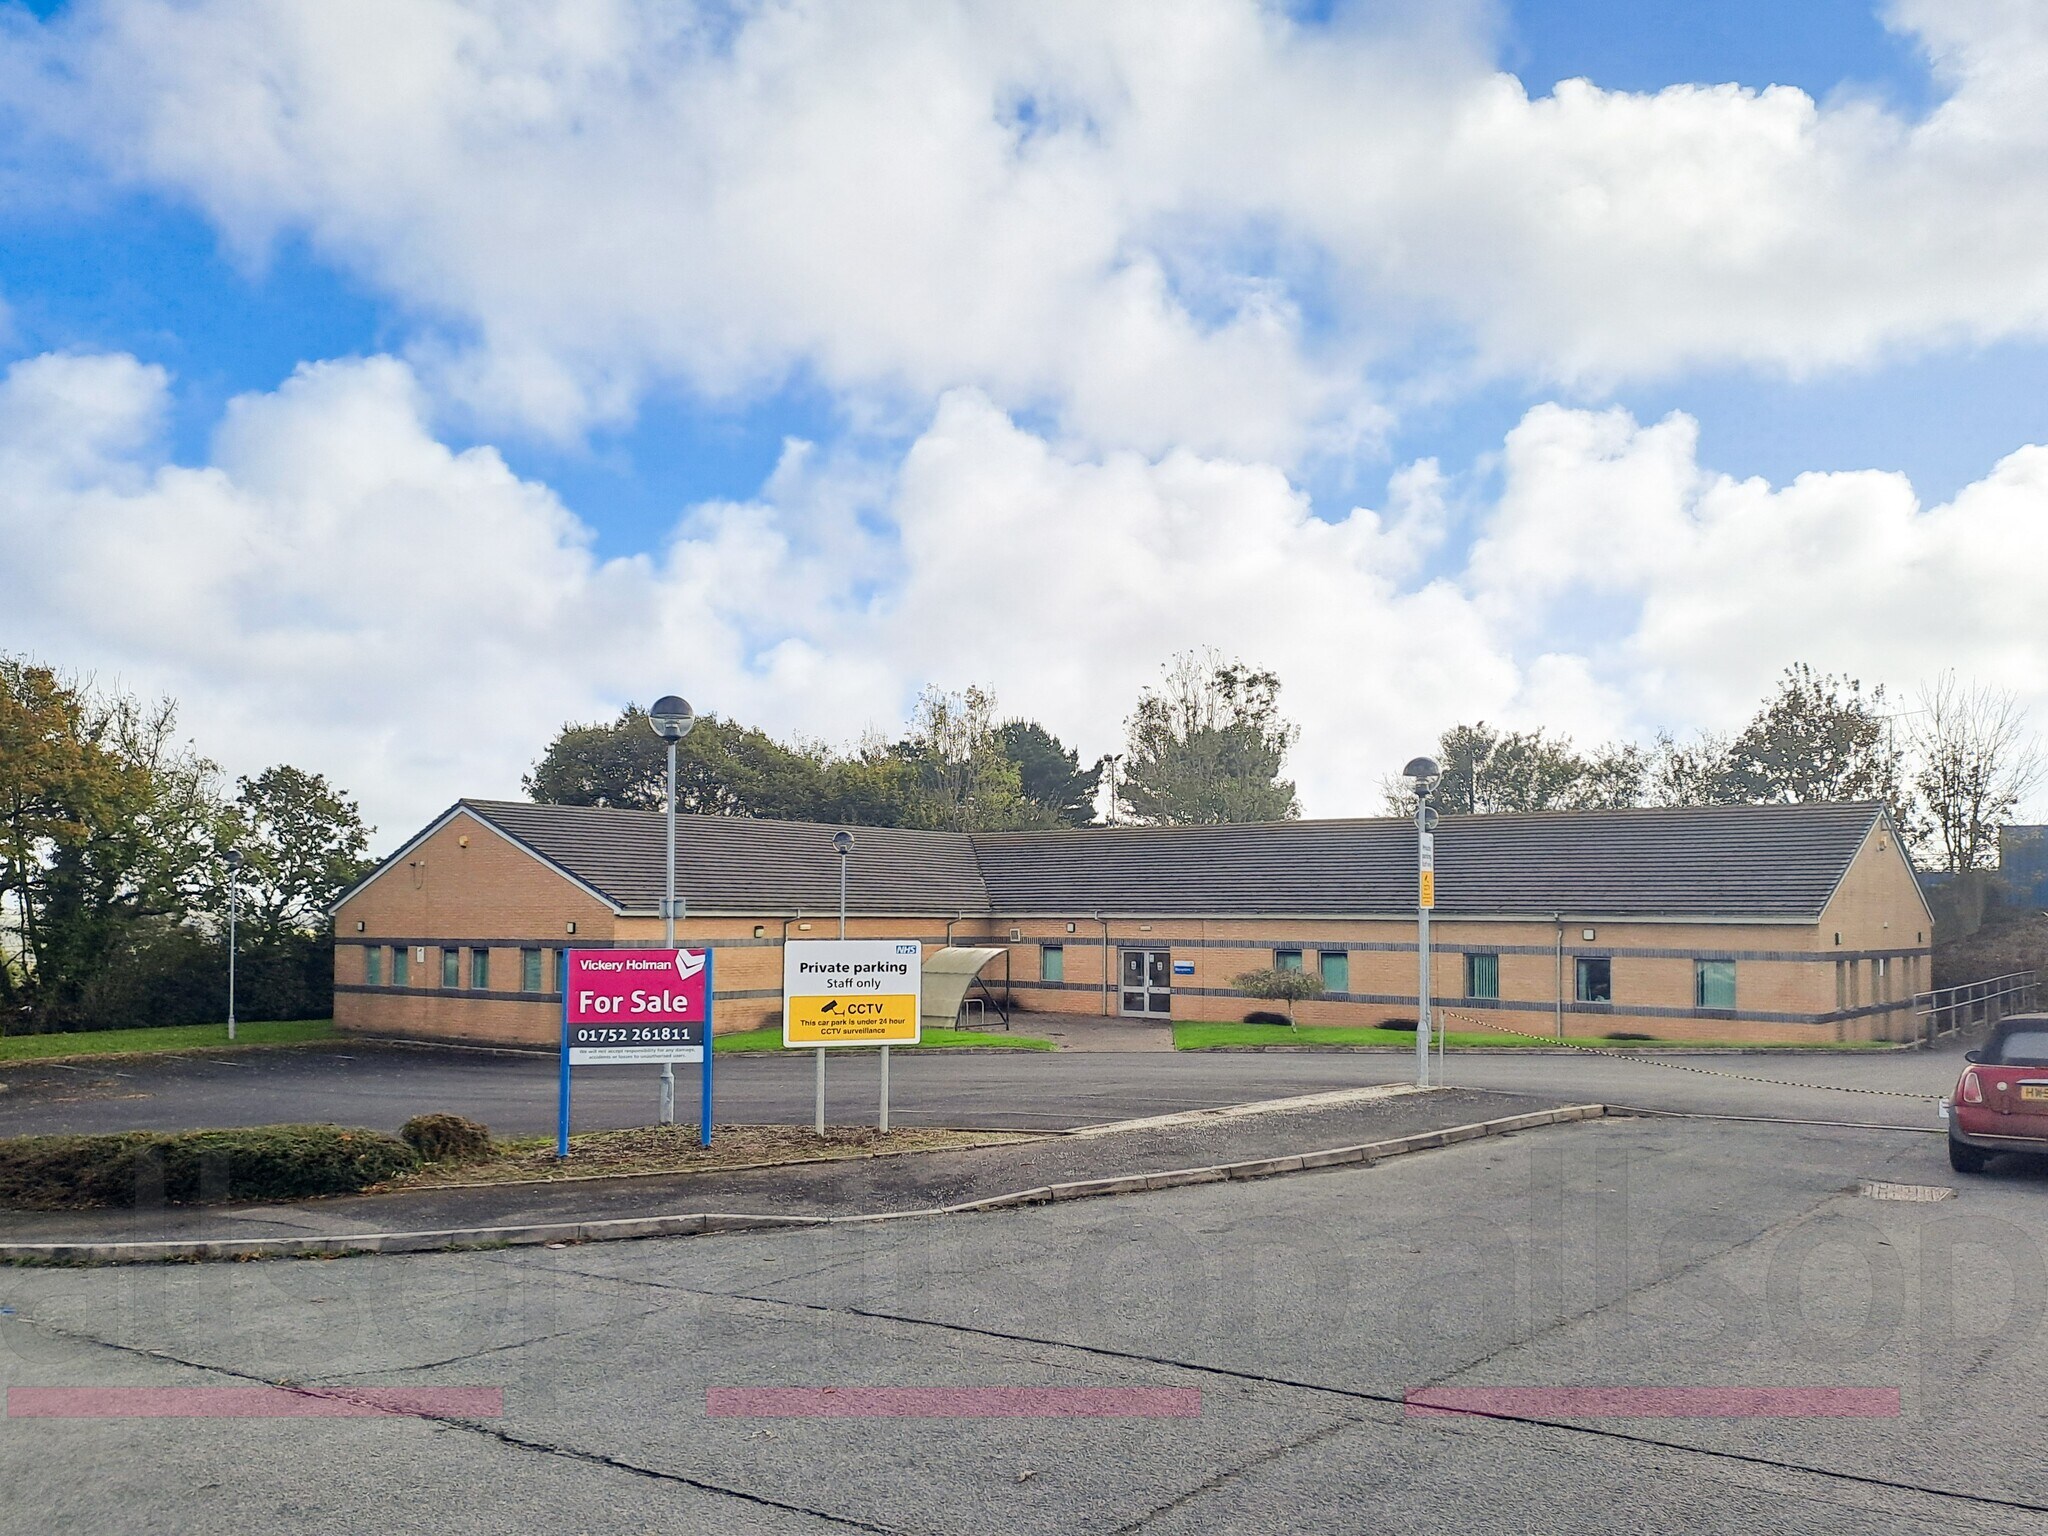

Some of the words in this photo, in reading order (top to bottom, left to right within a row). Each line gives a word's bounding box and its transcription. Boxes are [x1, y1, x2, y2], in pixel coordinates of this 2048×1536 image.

[896, 945, 916, 954] NHS
[580, 959, 624, 972] Vickery
[626, 959, 672, 970] Holman
[800, 962, 850, 973] Private
[854, 961, 907, 975] parking
[827, 978, 853, 988] Staff
[856, 978, 881, 990] only
[580, 990, 624, 1013] For
[630, 989, 688, 1013] Sale
[848, 1003, 883, 1014] CCTV
[831, 1019, 847, 1027] park
[578, 1029, 627, 1042] 01752
[631, 1027, 690, 1041] 261811
